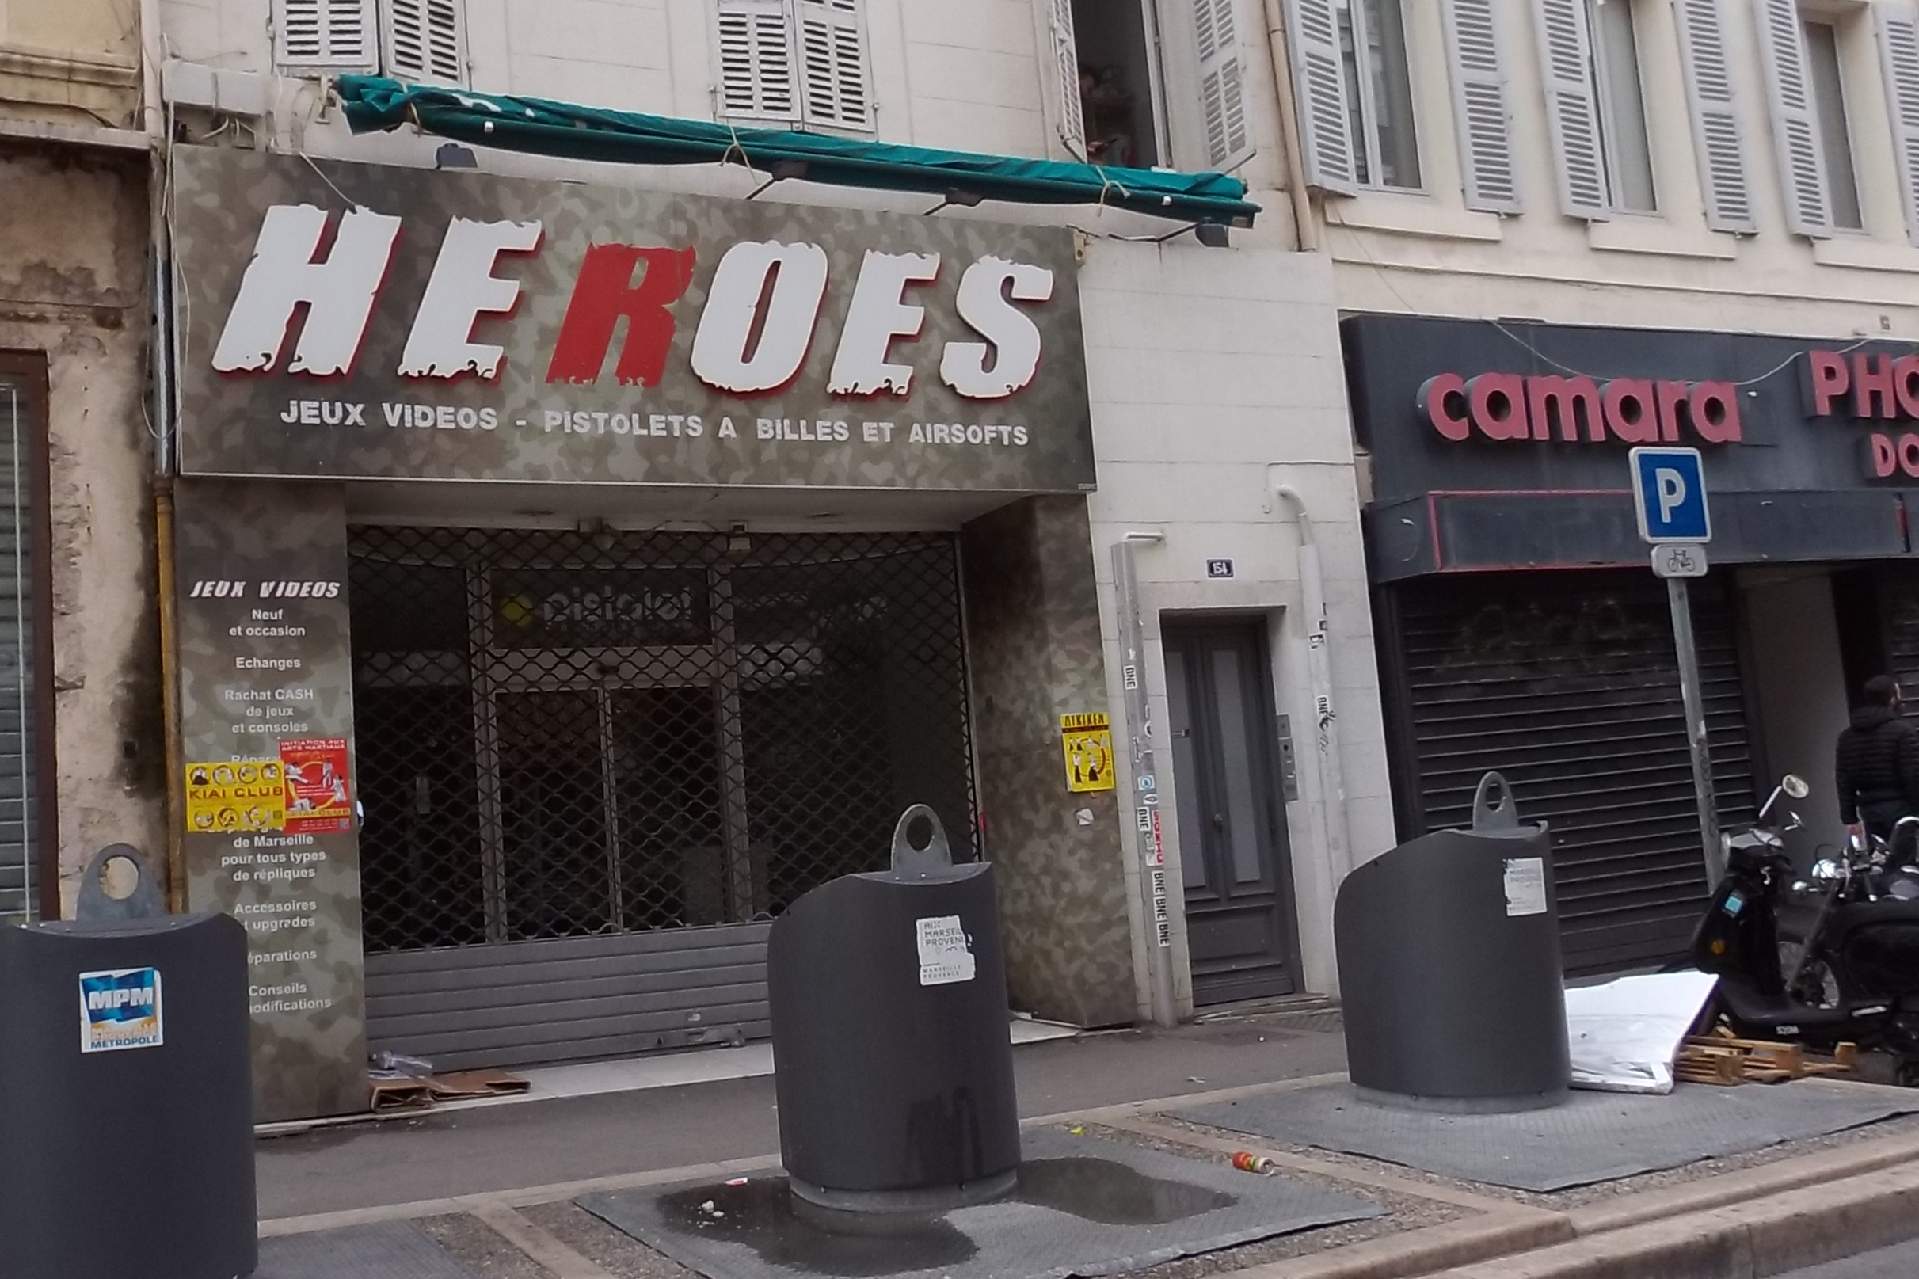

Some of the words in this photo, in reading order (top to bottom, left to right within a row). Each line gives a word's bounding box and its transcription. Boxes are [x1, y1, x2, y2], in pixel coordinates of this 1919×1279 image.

[212, 202, 1056, 400] HEROES
[1417, 372, 1743, 443] camara
[280, 400, 366, 426] JEUX
[382, 402, 498, 430] VIDEOS
[544, 410, 703, 438] PISTOLETS
[718, 416, 737, 439] A
[756, 418, 849, 441] BILLES
[862, 421, 895, 443] ET
[908, 423, 1029, 446] AIRSOFTS
[1655, 467, 1687, 524] P
[190, 580, 246, 598] JEUX
[259, 581, 341, 598] VIDEOS
[252, 608, 284, 620] Neuf
[229, 625, 242, 636] et
[246, 625, 306, 636] occasion
[224, 689, 271, 701] Rachat
[275, 689, 314, 700] CASH
[246, 705, 262, 717] de
[266, 705, 294, 719] jeux
[232, 723, 245, 733] et
[249, 721, 308, 733] consoles
[189, 788, 226, 800] KIAI
[234, 786, 283, 798] CLUB
[233, 837, 250, 848] de
[254, 834, 314, 848] Marseille
[221, 854, 253, 867] pour
[256, 853, 287, 864] tous
[290, 850, 326, 864] types
[233, 870, 250, 882] de
[253, 867, 316, 882] répliques
[233, 900, 318, 915] Accessoires
[252, 916, 316, 932] upgrades
[247, 949, 318, 966] éparations
[248, 982, 308, 997] Conseils
[88, 987, 154, 1010] MPM
[248, 997, 333, 1015] odifications
[90, 1036, 157, 1048] METROPOLE
